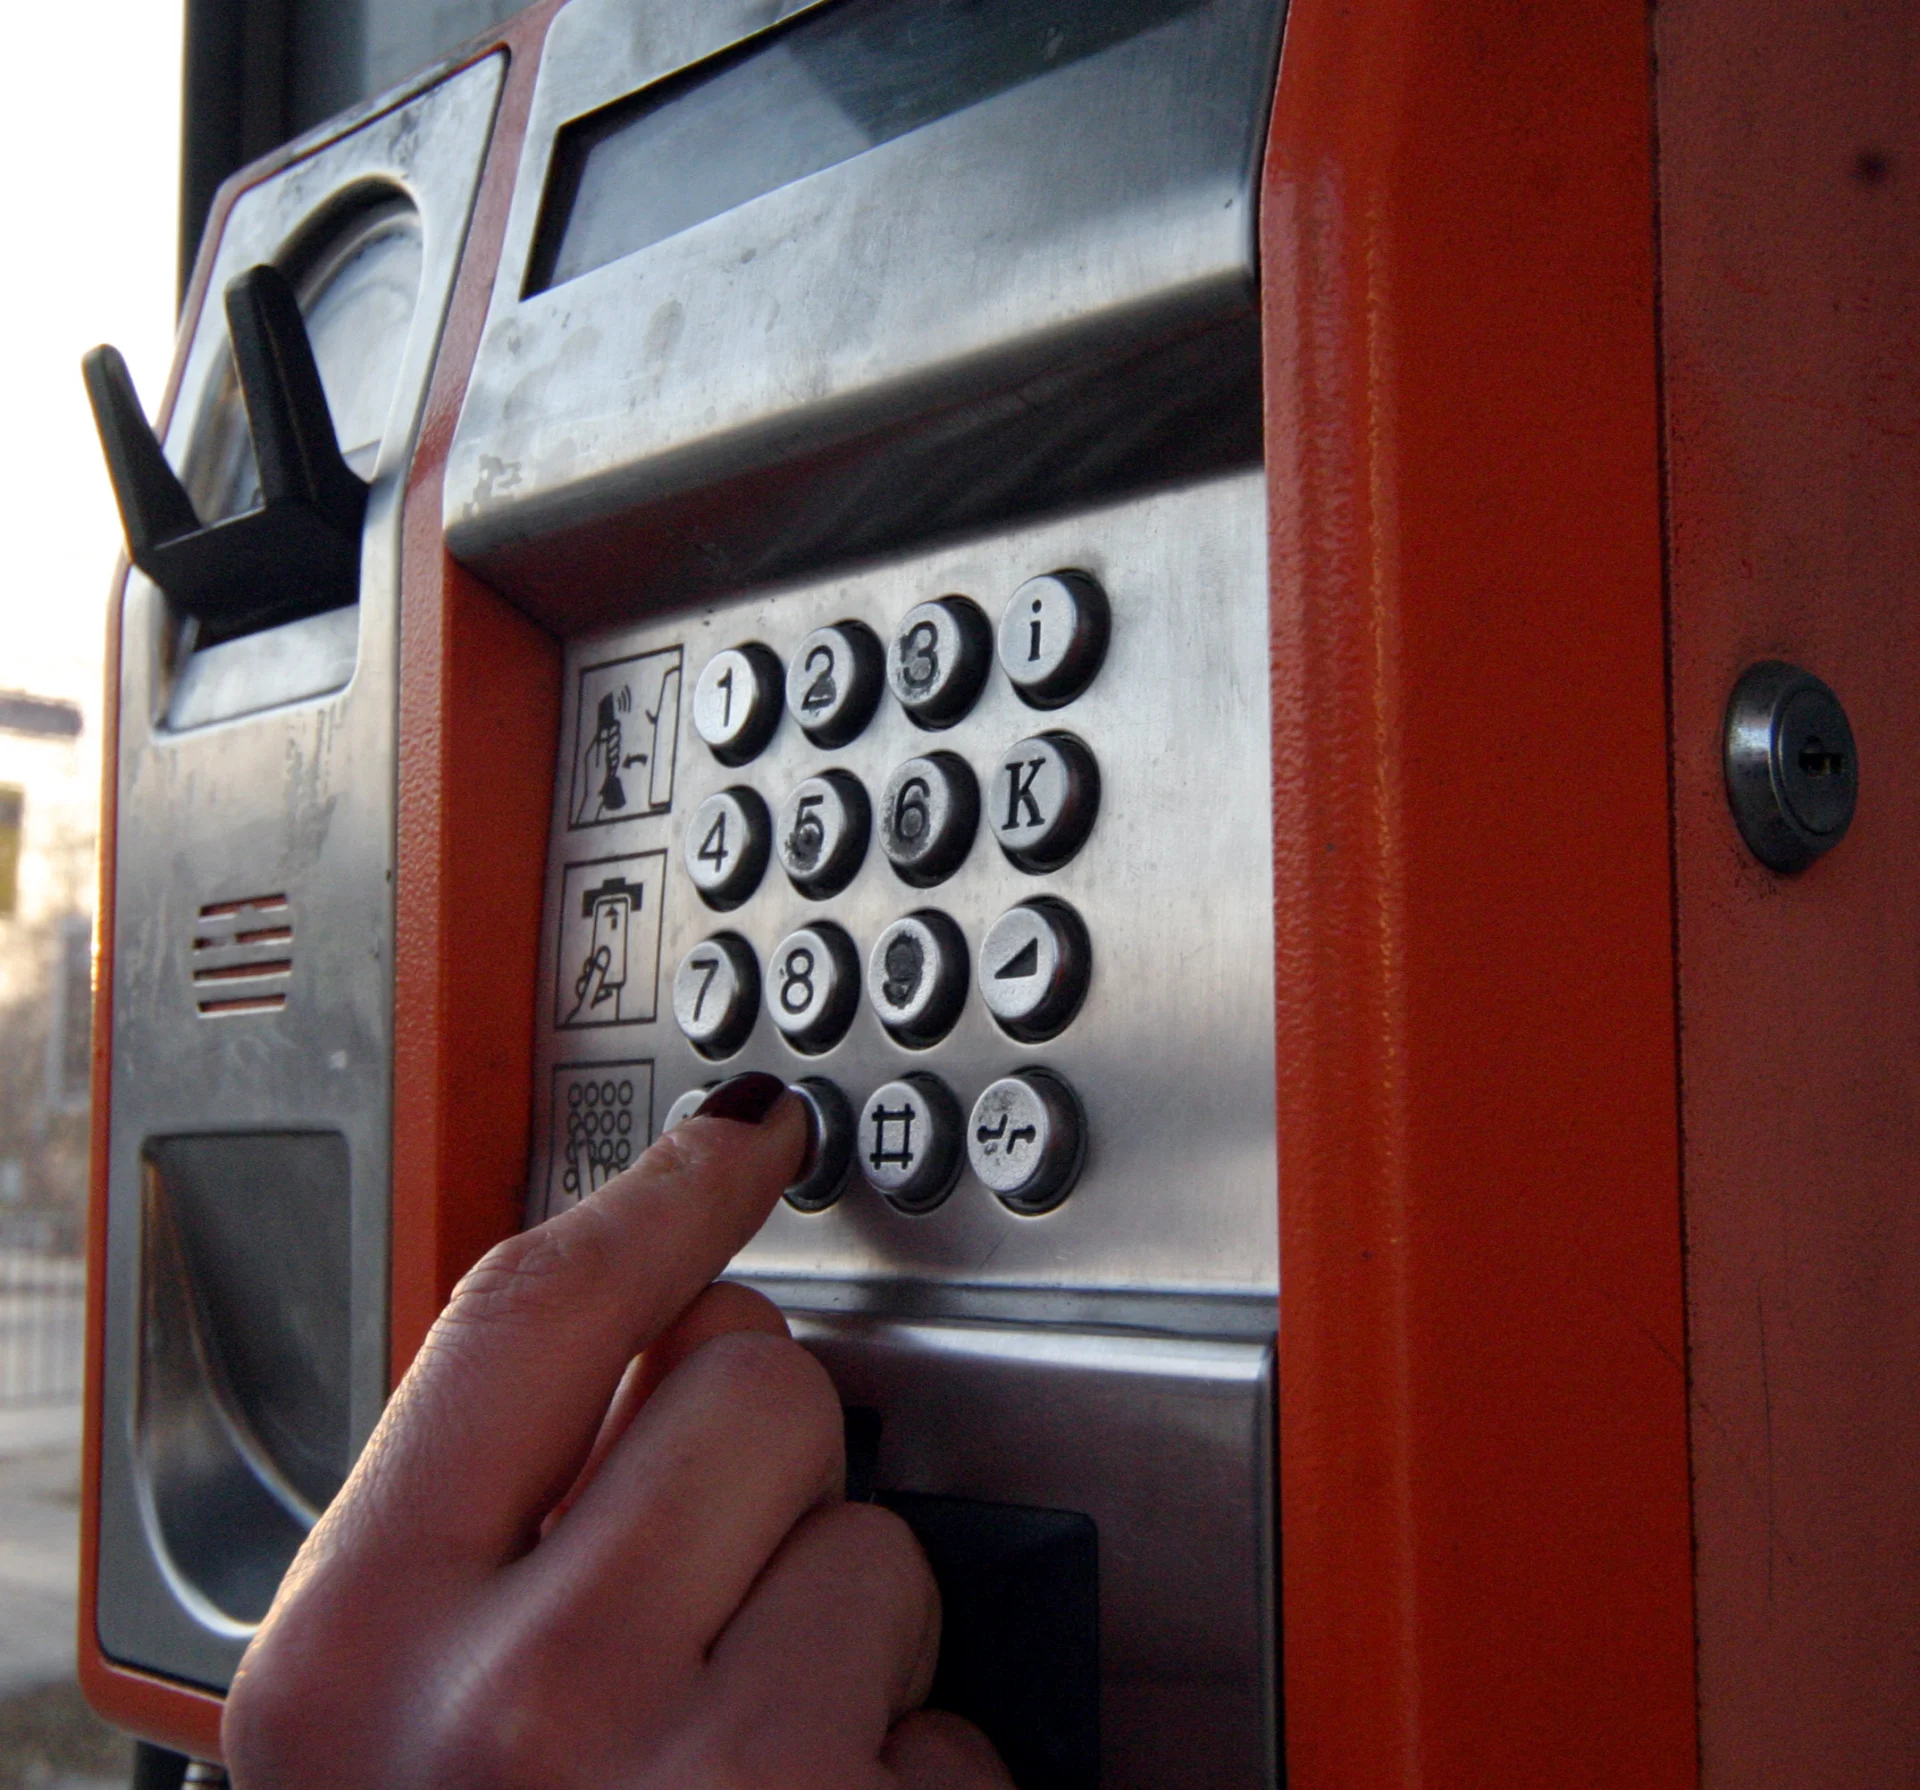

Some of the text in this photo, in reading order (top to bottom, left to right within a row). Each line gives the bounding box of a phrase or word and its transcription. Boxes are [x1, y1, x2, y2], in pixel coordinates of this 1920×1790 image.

[716, 599, 1043, 729] 1 2 3 i
[697, 757, 1047, 874] 4 5 6 K
[690, 959, 719, 1022] 7
[780, 947, 815, 1016] 8
